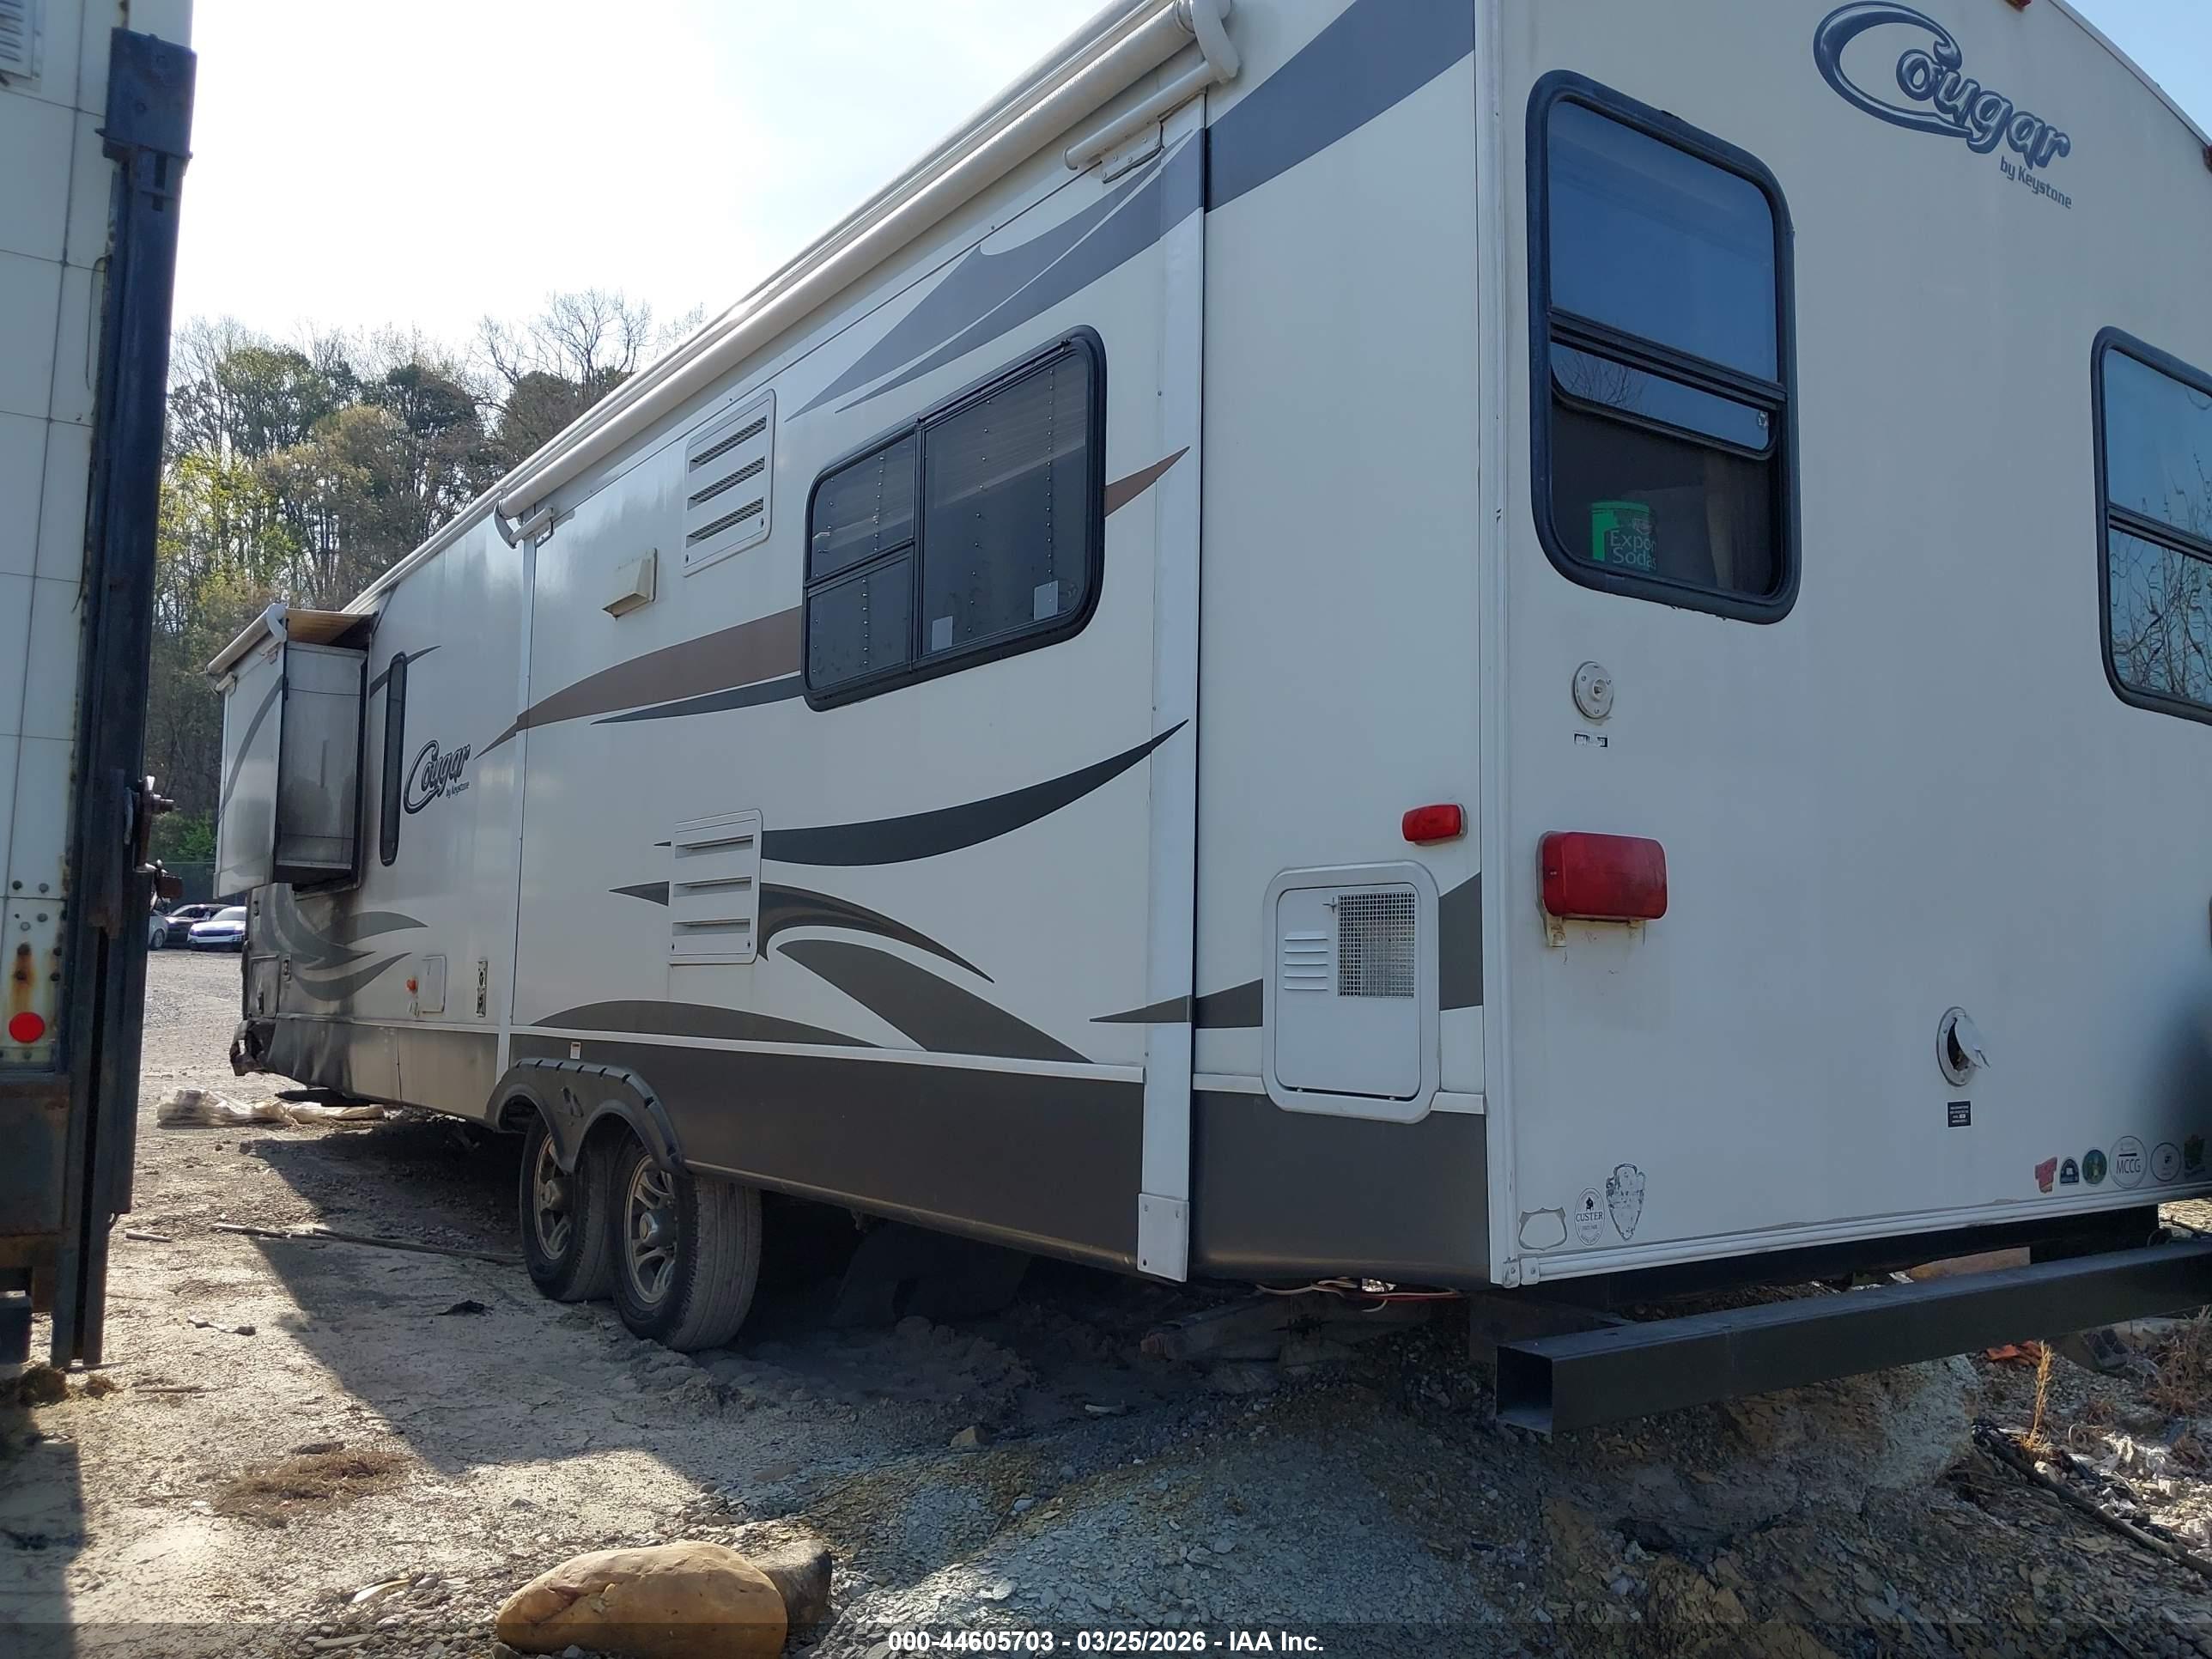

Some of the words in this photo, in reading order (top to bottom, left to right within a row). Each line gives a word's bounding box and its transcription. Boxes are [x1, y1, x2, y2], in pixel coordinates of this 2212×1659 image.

[1813, 0, 2071, 170] Cougar
[2000, 155, 2014, 182] by
[2018, 165, 2072, 210] Keystone
[404, 739, 471, 815] Cougar
[2116, 1158, 2141, 1175] MCCG
[1575, 1211, 1603, 1223] CUSTER
